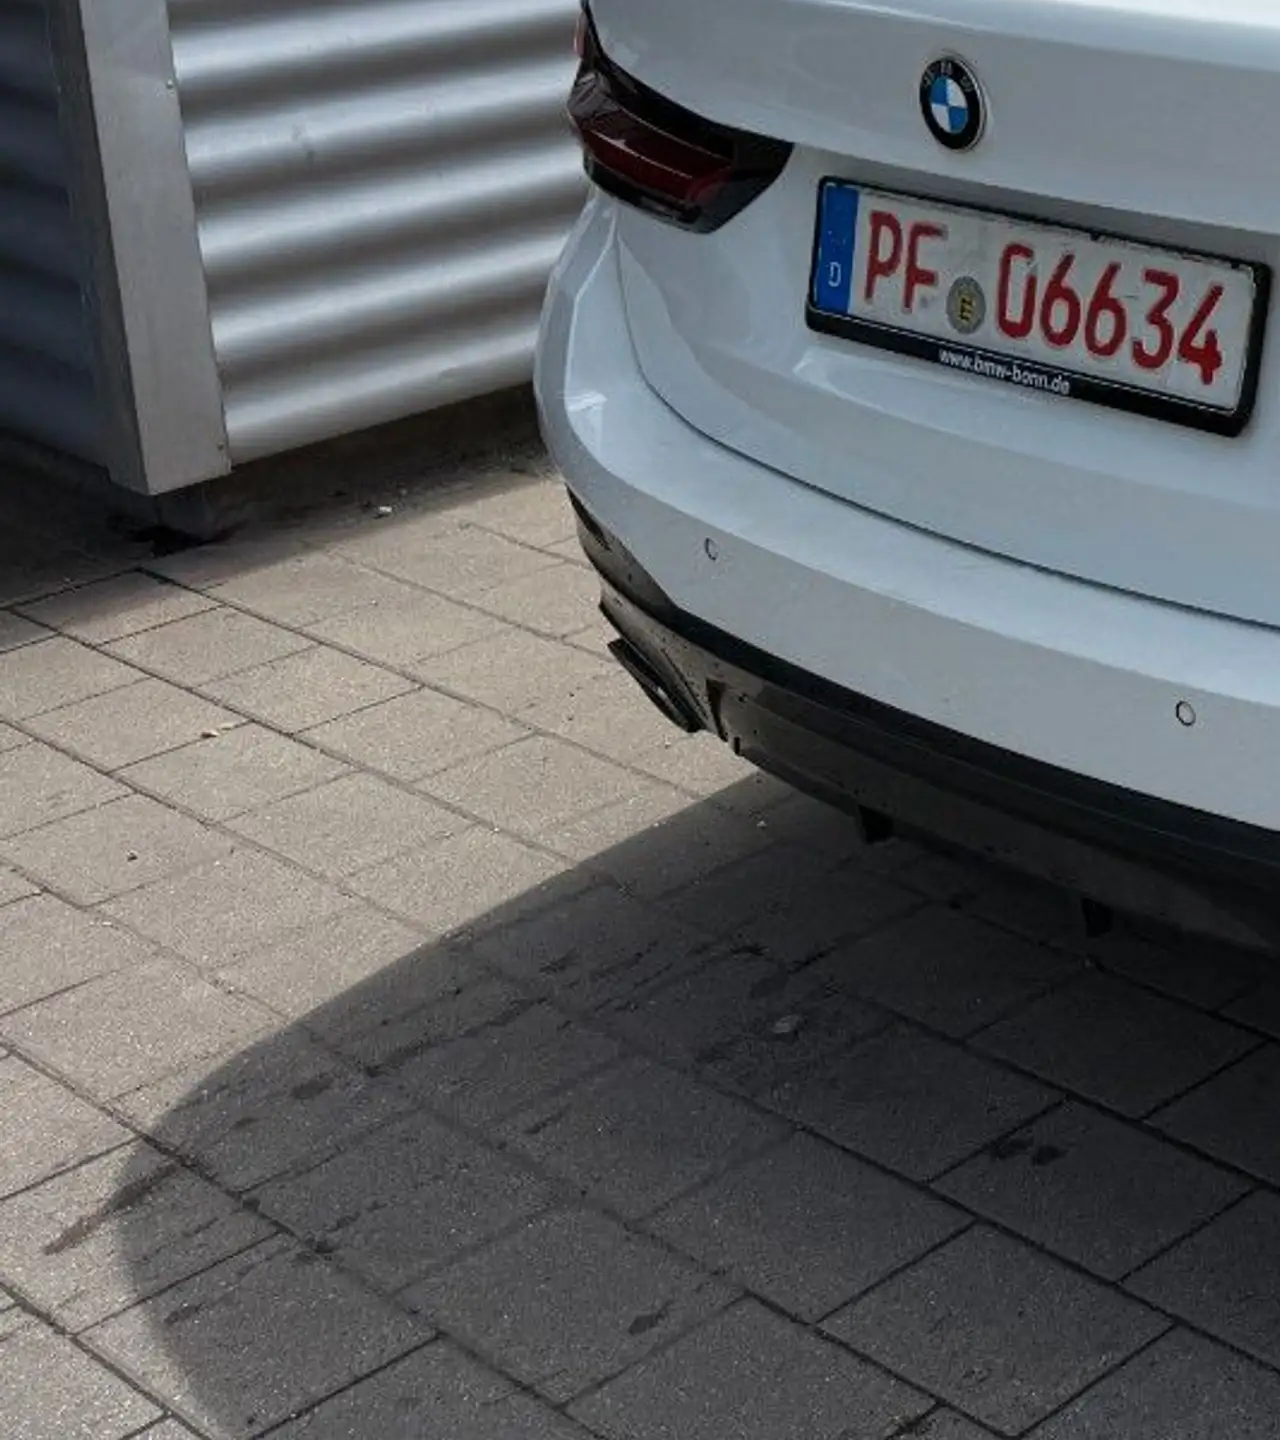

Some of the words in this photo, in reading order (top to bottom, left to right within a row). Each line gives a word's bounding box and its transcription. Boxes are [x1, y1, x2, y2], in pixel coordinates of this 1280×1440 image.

[864, 210, 948, 313] PF
[996, 242, 1224, 386] 06634
[938, 349, 1071, 396] www.bmw-bonn.de
